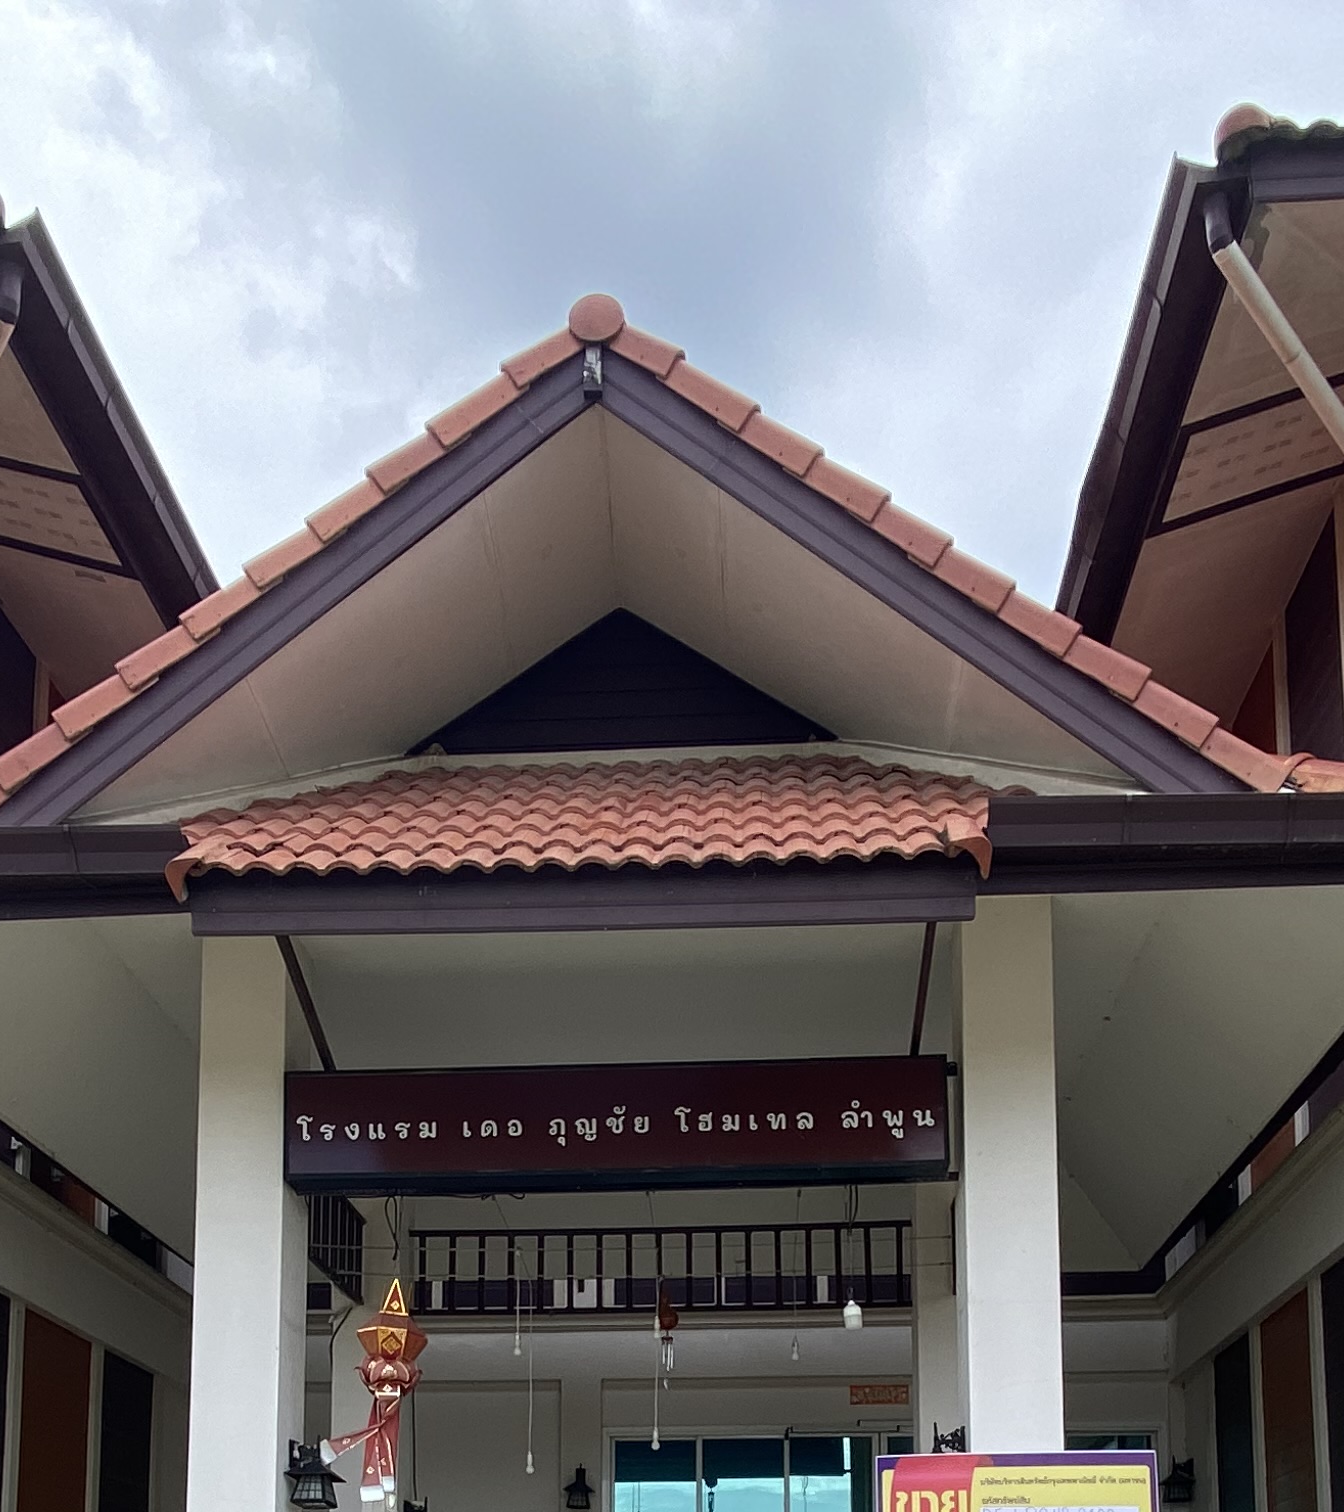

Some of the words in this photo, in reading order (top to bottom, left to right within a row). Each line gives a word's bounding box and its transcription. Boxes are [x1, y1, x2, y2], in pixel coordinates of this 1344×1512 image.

[296, 1114, 438, 1142] โรงแรม
[462, 1118, 524, 1138] เดอ
[548, 1105, 650, 1147] ภุญชัย
[673, 1106, 815, 1133] โฮมเทล
[840, 1100, 936, 1139] ลำพูน
